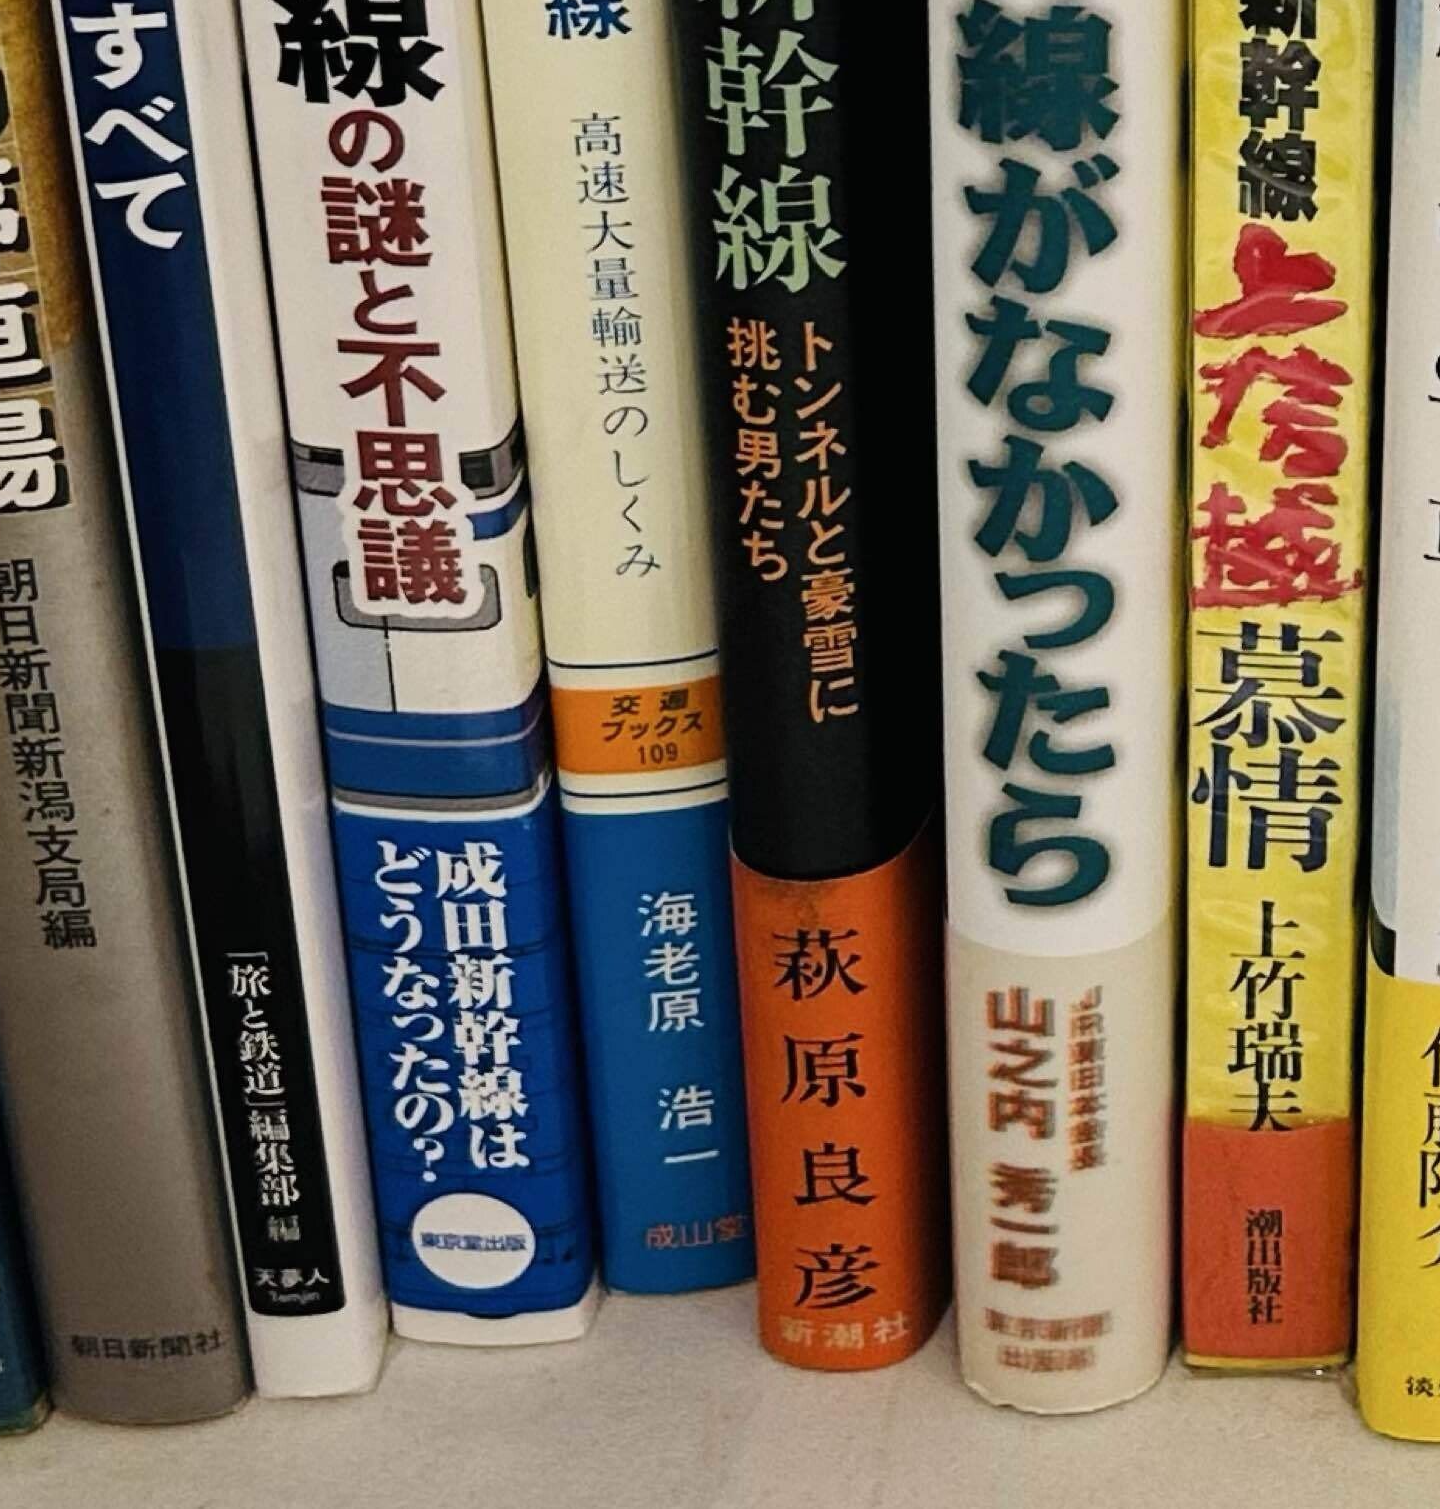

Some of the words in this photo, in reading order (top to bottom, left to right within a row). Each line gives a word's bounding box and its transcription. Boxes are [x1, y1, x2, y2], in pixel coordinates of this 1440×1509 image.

[571, 111, 662, 579] 高速大量輸送のしくみ
[726, 317, 790, 583] 挑む男たち
[794, 320, 860, 723] トンネルと豪雪に
[601, 716, 704, 743] ブックス
[611, 687, 690, 716] 交通
[636, 742, 679, 765] 109
[1191, 621, 1347, 874] 慕情
[373, 840, 457, 1183] どうなったの?
[436, 840, 532, 1170] 成田新幹線は
[638, 891, 704, 1034] 海老原
[1228, 900, 1308, 1133] 上竹瑞夫
[660, 1086, 719, 1165] 浩一
[772, 929, 879, 1310] 萩原良彦
[70, 1328, 225, 1360] 朝日新聞社
[777, 1314, 912, 1349] 新潮社
[1242, 1208, 1285, 1326] 潮出版社
